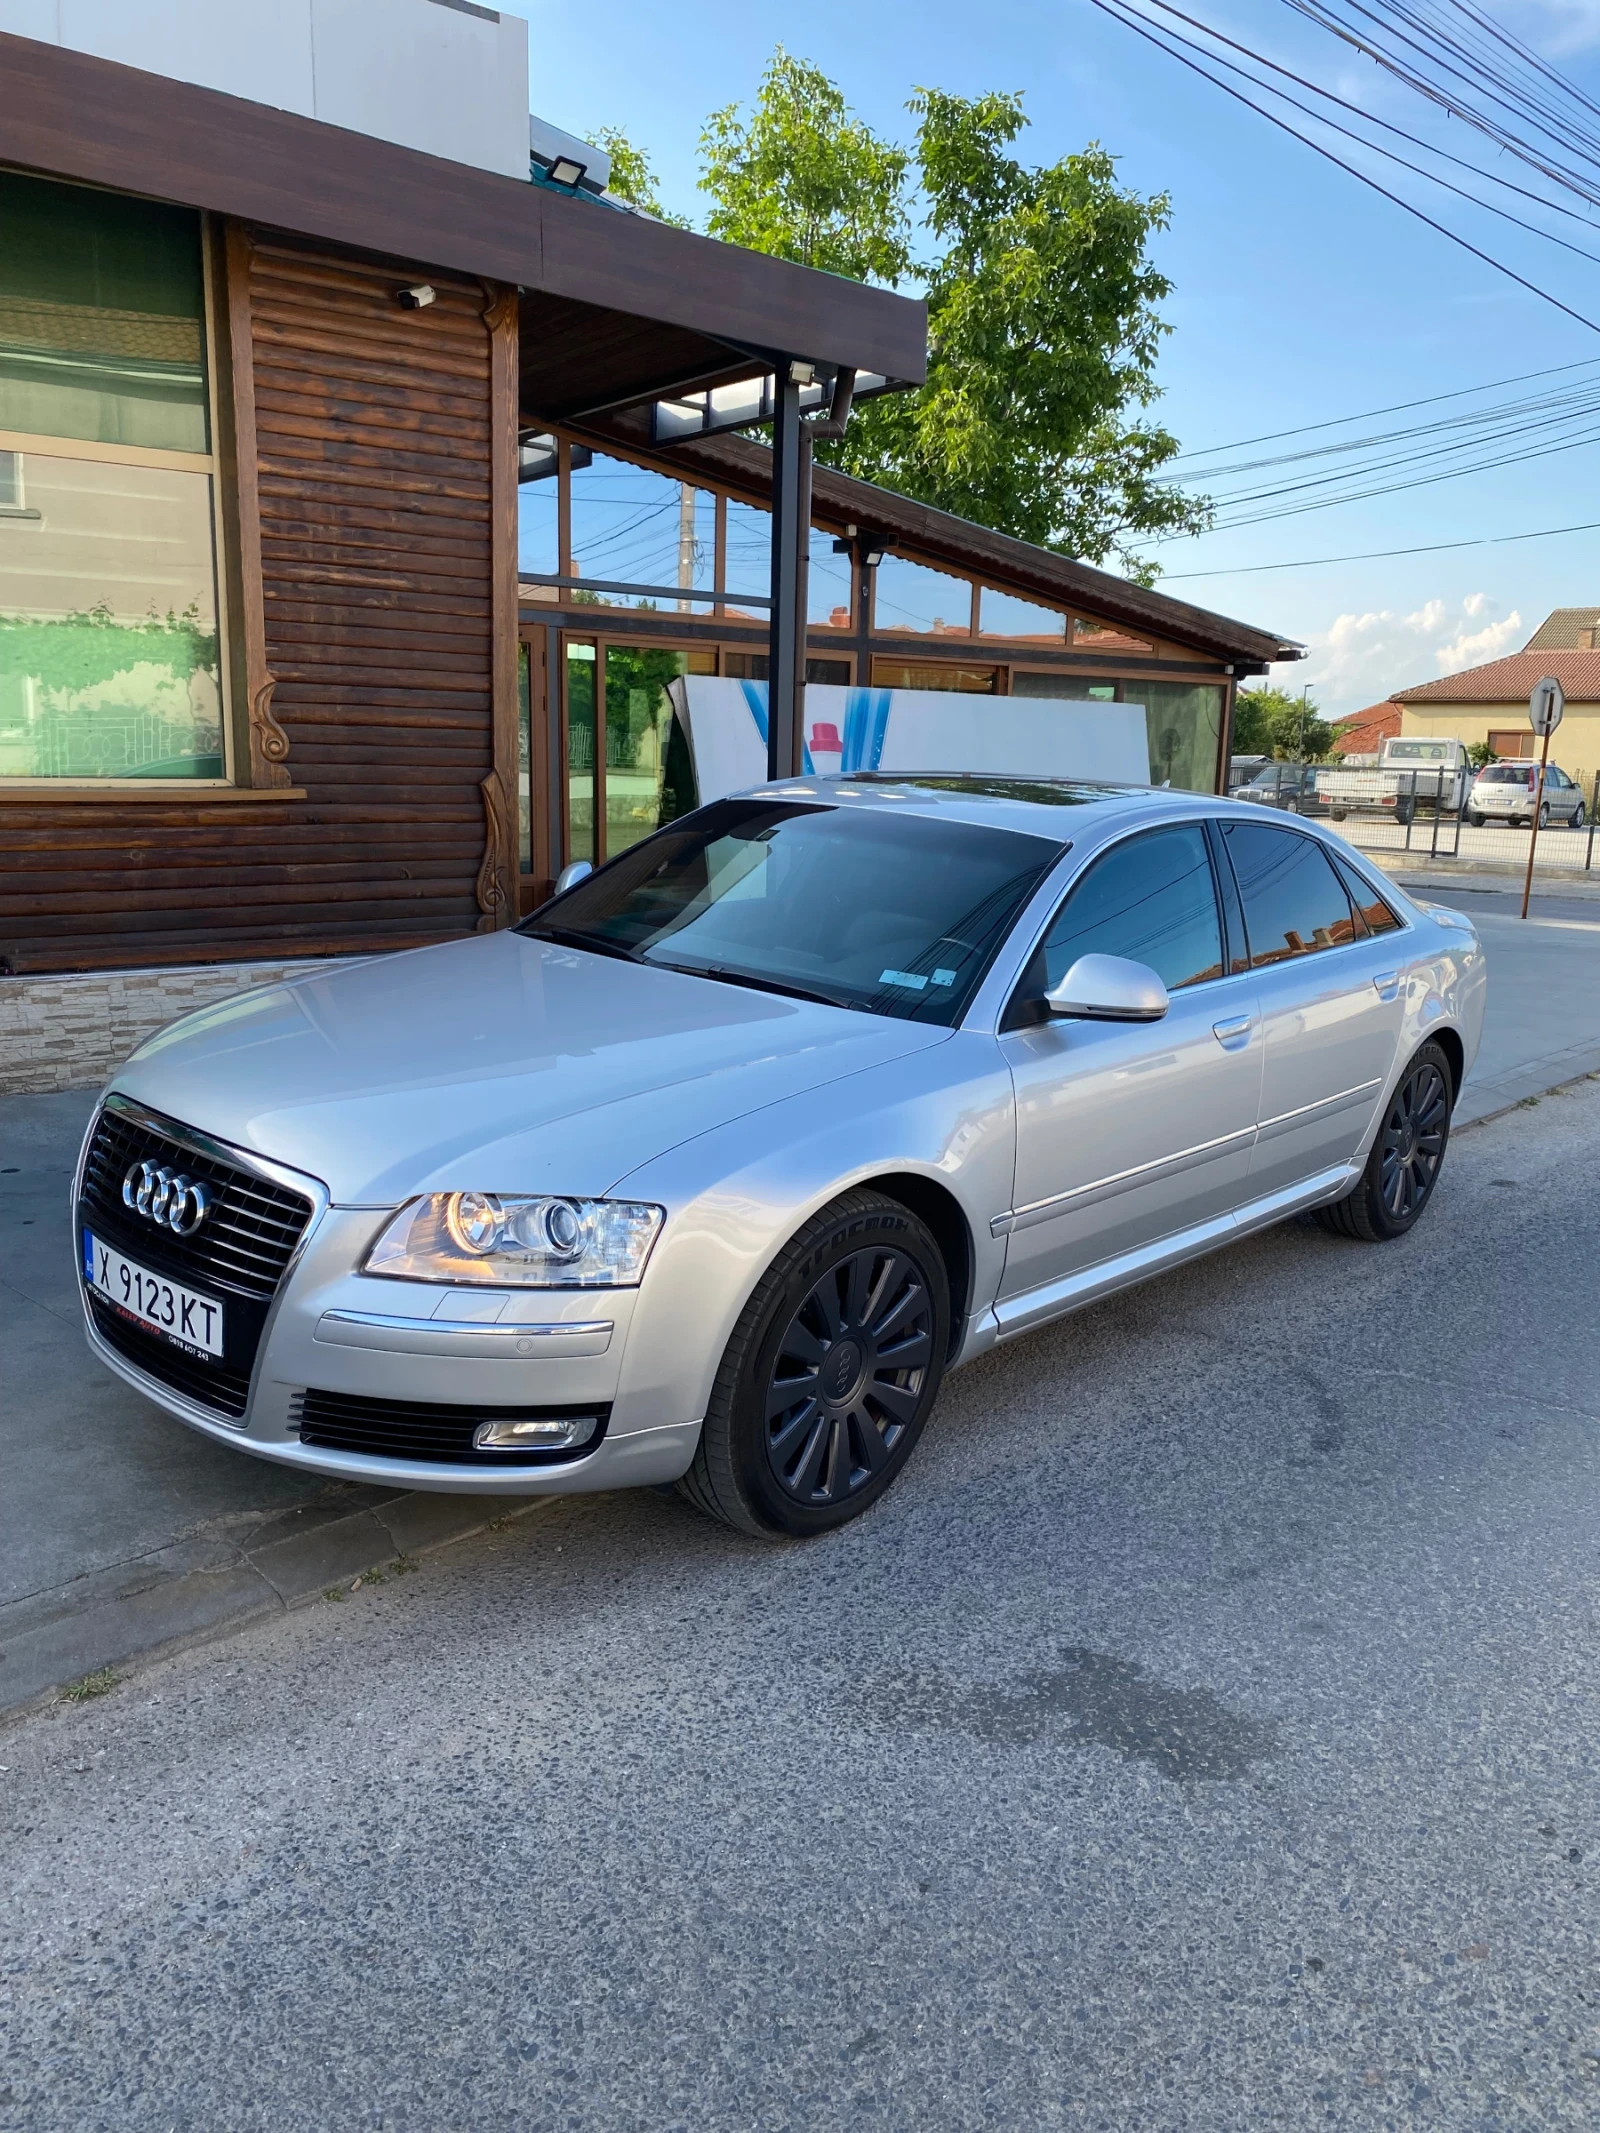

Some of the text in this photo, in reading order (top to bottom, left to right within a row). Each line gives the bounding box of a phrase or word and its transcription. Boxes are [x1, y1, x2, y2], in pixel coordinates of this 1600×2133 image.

[99, 1246, 110, 1291] X
[140, 1320, 161, 1335] AUTO
[196, 1350, 209, 1362] 243
